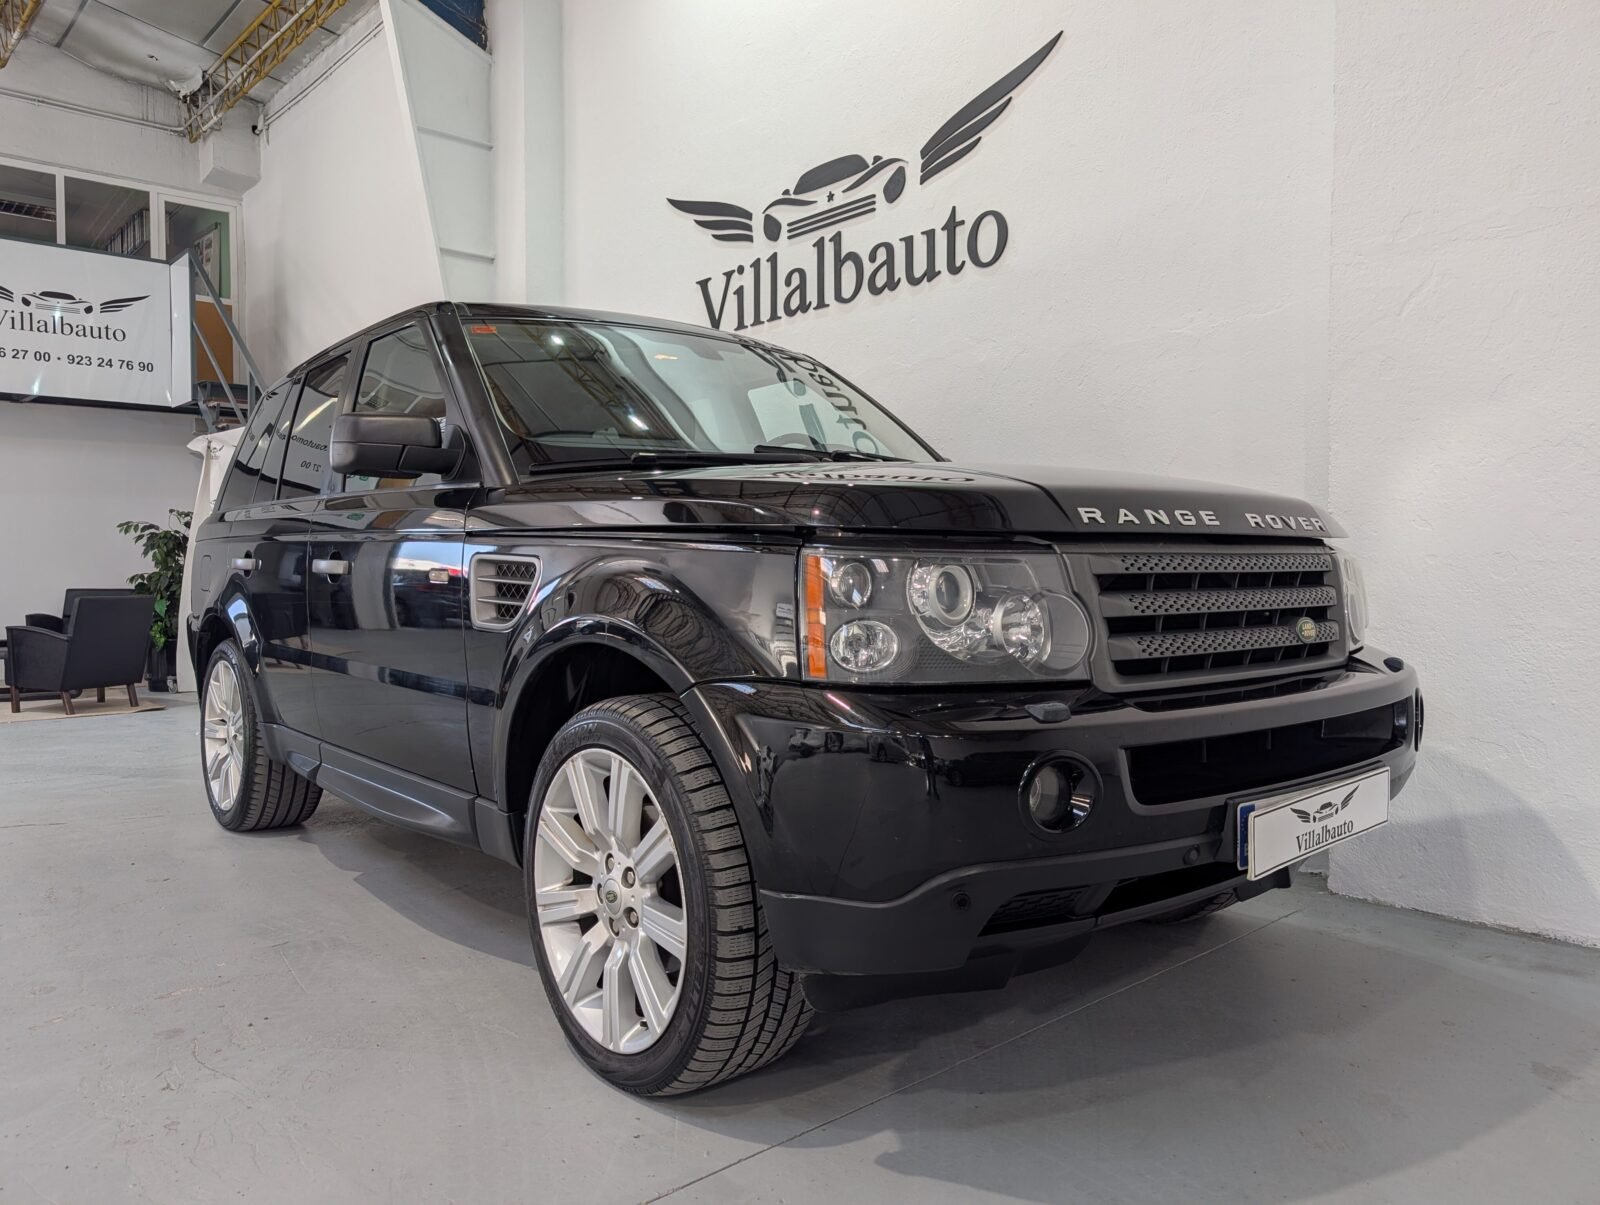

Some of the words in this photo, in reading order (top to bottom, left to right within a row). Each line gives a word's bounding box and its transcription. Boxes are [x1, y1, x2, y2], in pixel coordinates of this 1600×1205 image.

[695, 205, 1009, 331] Villalbauto
[11, 348, 28, 360] 27
[34, 350, 51, 362] 00
[67, 354, 92, 366] 923
[97, 357, 113, 368] 24
[118, 359, 134, 371] 76
[138, 361, 154, 372] 90
[1077, 507, 1220, 526] RANGE
[1245, 512, 1327, 532] ROVER
[1295, 819, 1354, 853] Villalbauto
